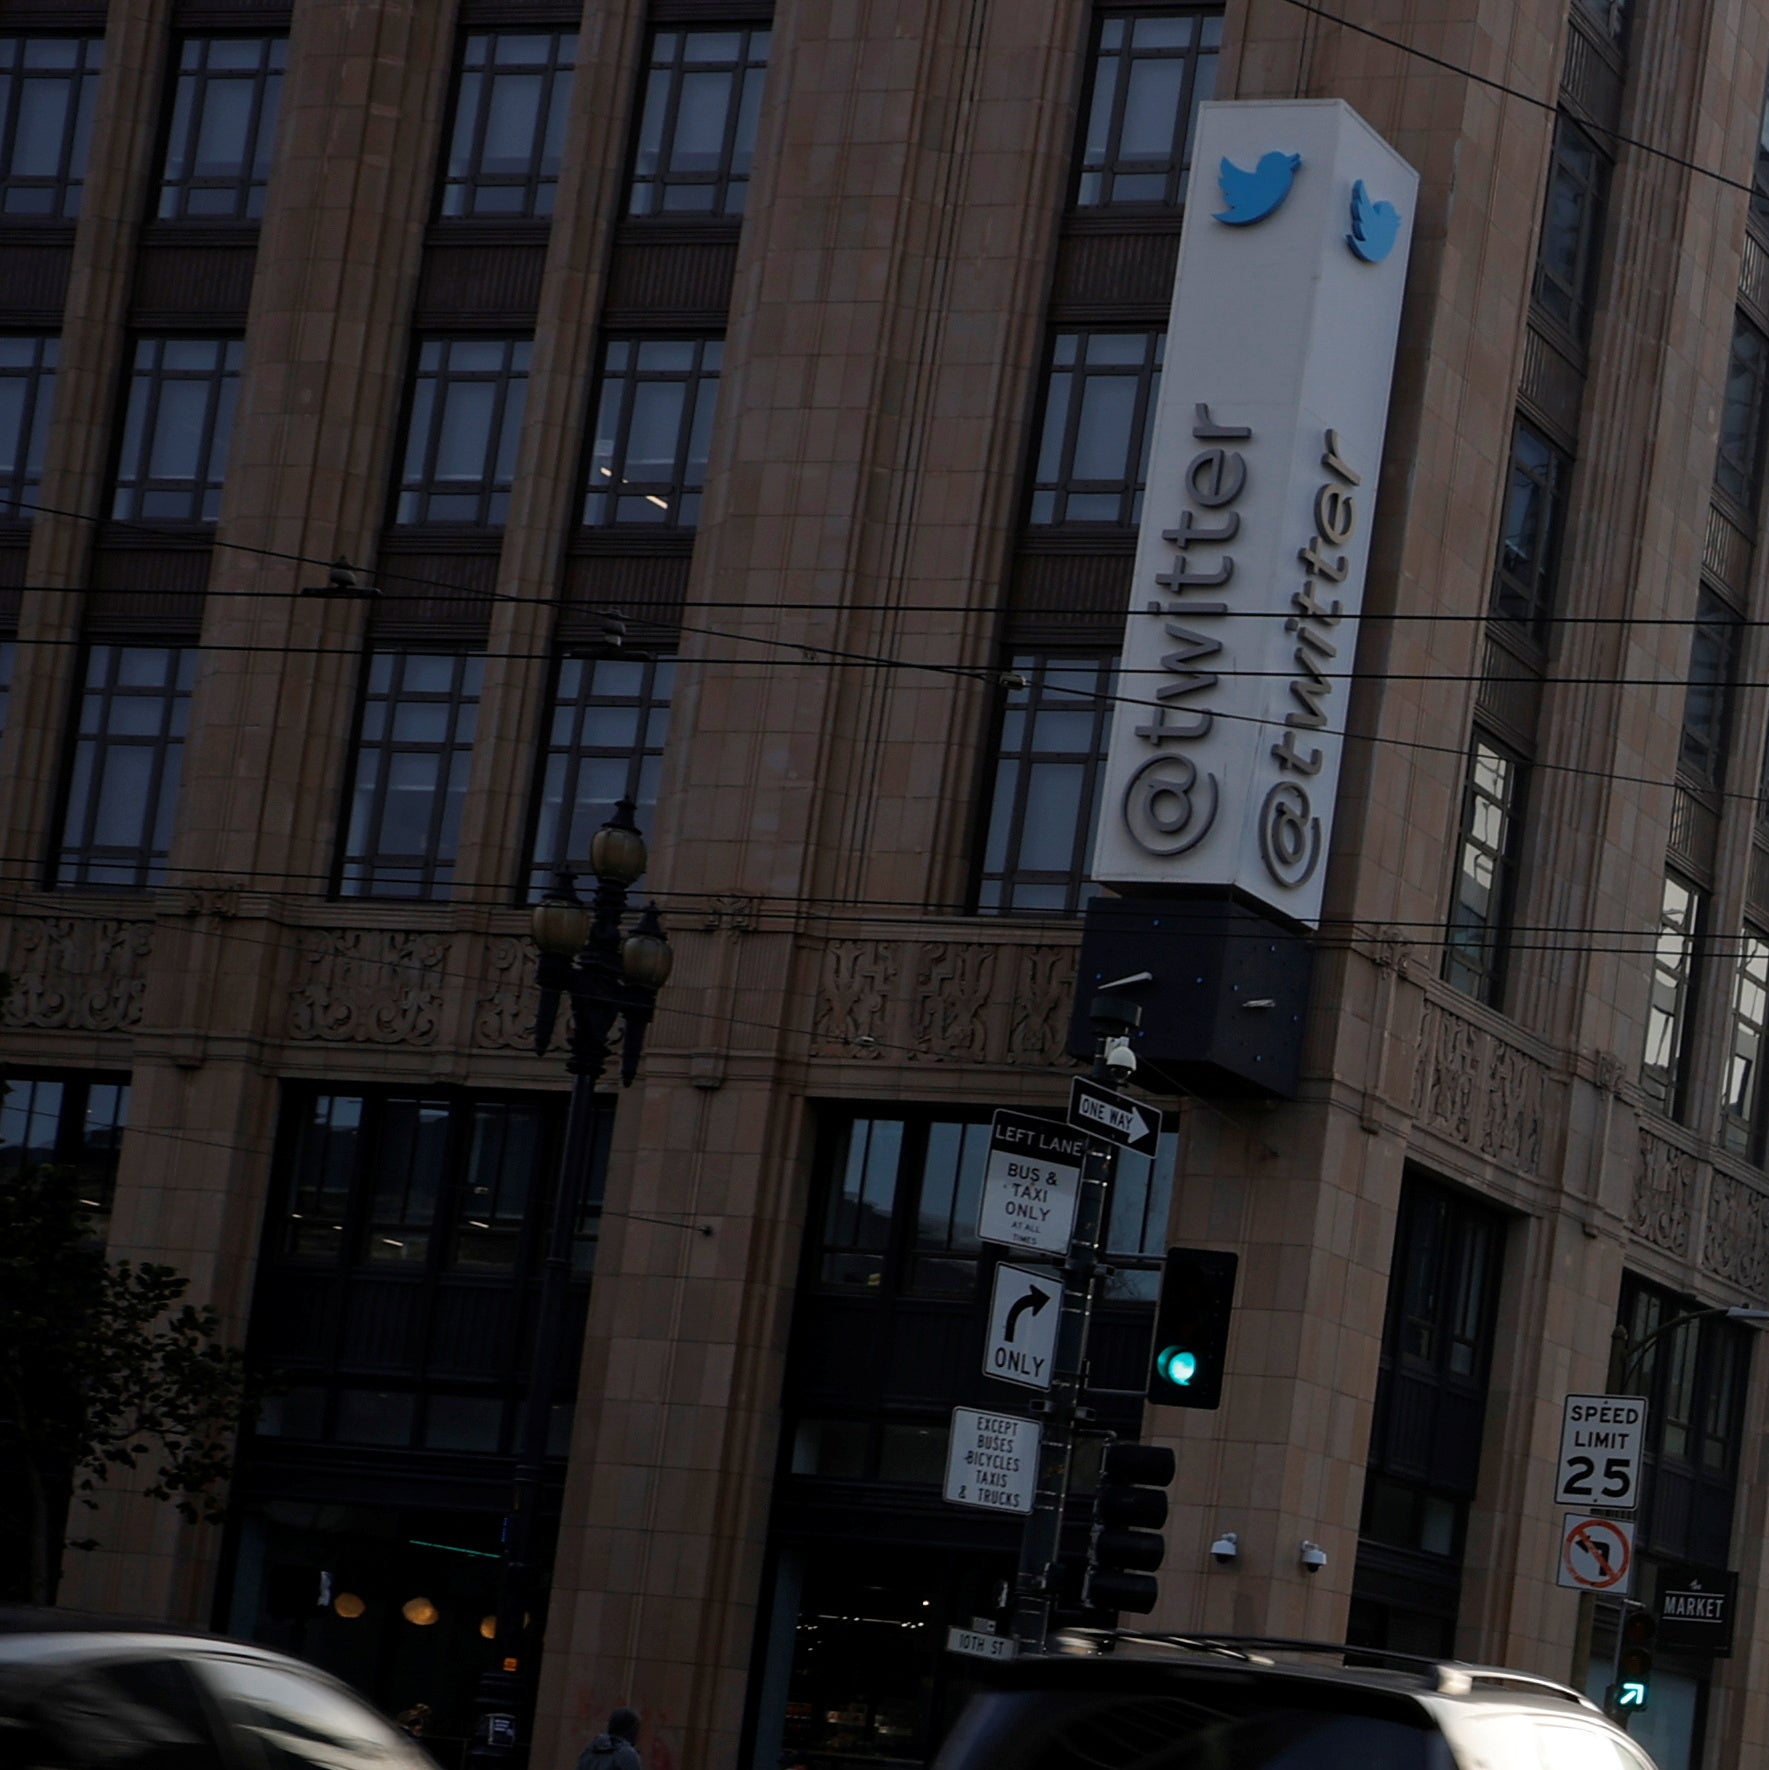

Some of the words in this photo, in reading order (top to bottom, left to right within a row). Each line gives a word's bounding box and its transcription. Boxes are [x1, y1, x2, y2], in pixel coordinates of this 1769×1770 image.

[1122, 403, 1252, 857] @twitter
[1258, 428, 1363, 890] @twitter
[1081, 1098, 1105, 1120] ONE
[1109, 1110, 1133, 1131] WAY
[995, 1124, 1036, 1146] LEFT
[1039, 1135, 1083, 1157] LANE
[1007, 1162, 1041, 1182] BUS
[1045, 1171, 1058, 1186] &
[1013, 1183, 1048, 1203] TAXI
[1005, 1201, 1050, 1222] ONLY
[1011, 1221, 1023, 1230] AT
[1025, 1223, 1041, 1234] ALL
[1013, 1233, 1037, 1245] TIMES
[994, 1347, 1044, 1377] ONLY
[1570, 1405, 1639, 1425] SPEED
[976, 1416, 1019, 1437] EXCEPT
[976, 1434, 1014, 1454] BUSES
[1575, 1430, 1629, 1450] LIMIT
[966, 1450, 1020, 1472] BICYCLES
[976, 1469, 1008, 1488] TAXIS
[1563, 1456, 1631, 1498] 25
[958, 1485, 967, 1499] &
[978, 1488, 1021, 1508] TRUCKS
[1663, 1596, 1724, 1618] MARKET
[960, 1633, 985, 1652] 10TH
[991, 1640, 1005, 1655] ST
